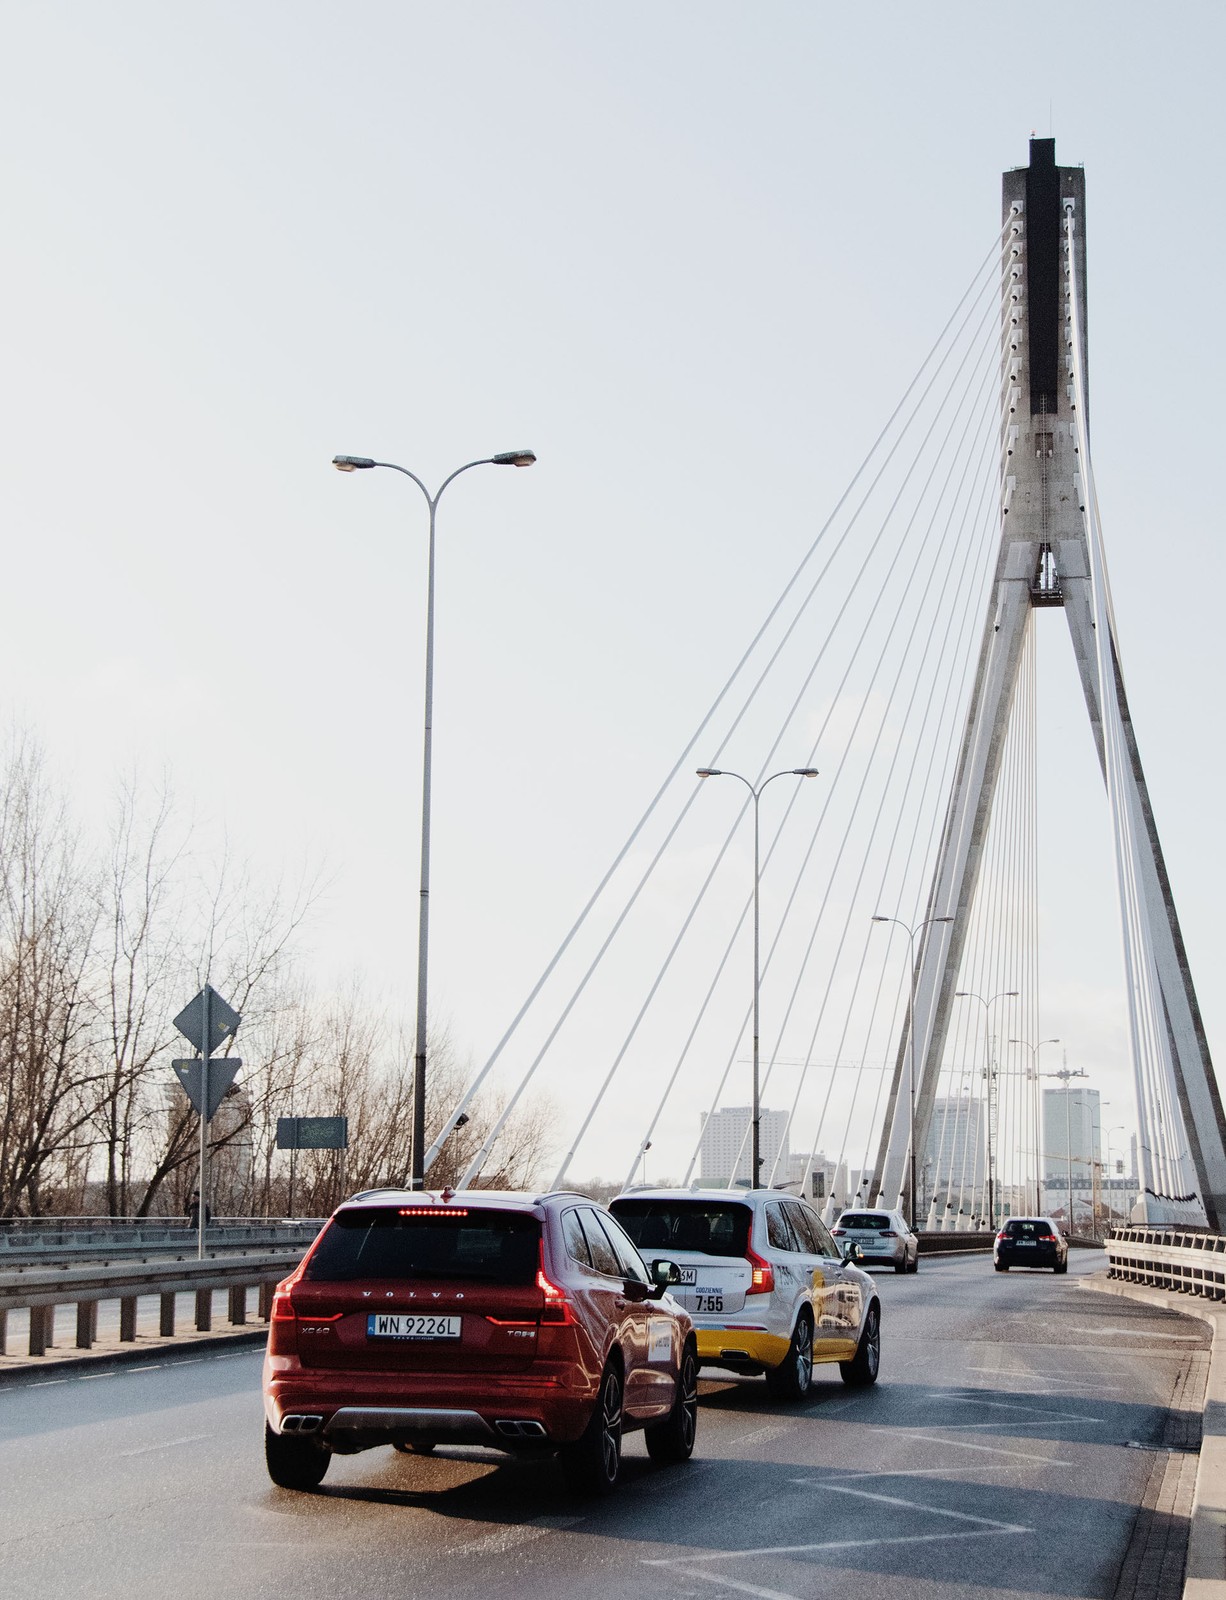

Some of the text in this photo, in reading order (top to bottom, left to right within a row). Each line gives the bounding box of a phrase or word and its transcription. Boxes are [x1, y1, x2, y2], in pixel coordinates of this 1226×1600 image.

[696, 1295, 723, 1311] 7:55
[379, 1316, 400, 1334] WN
[406, 1317, 456, 1335] 9226L
